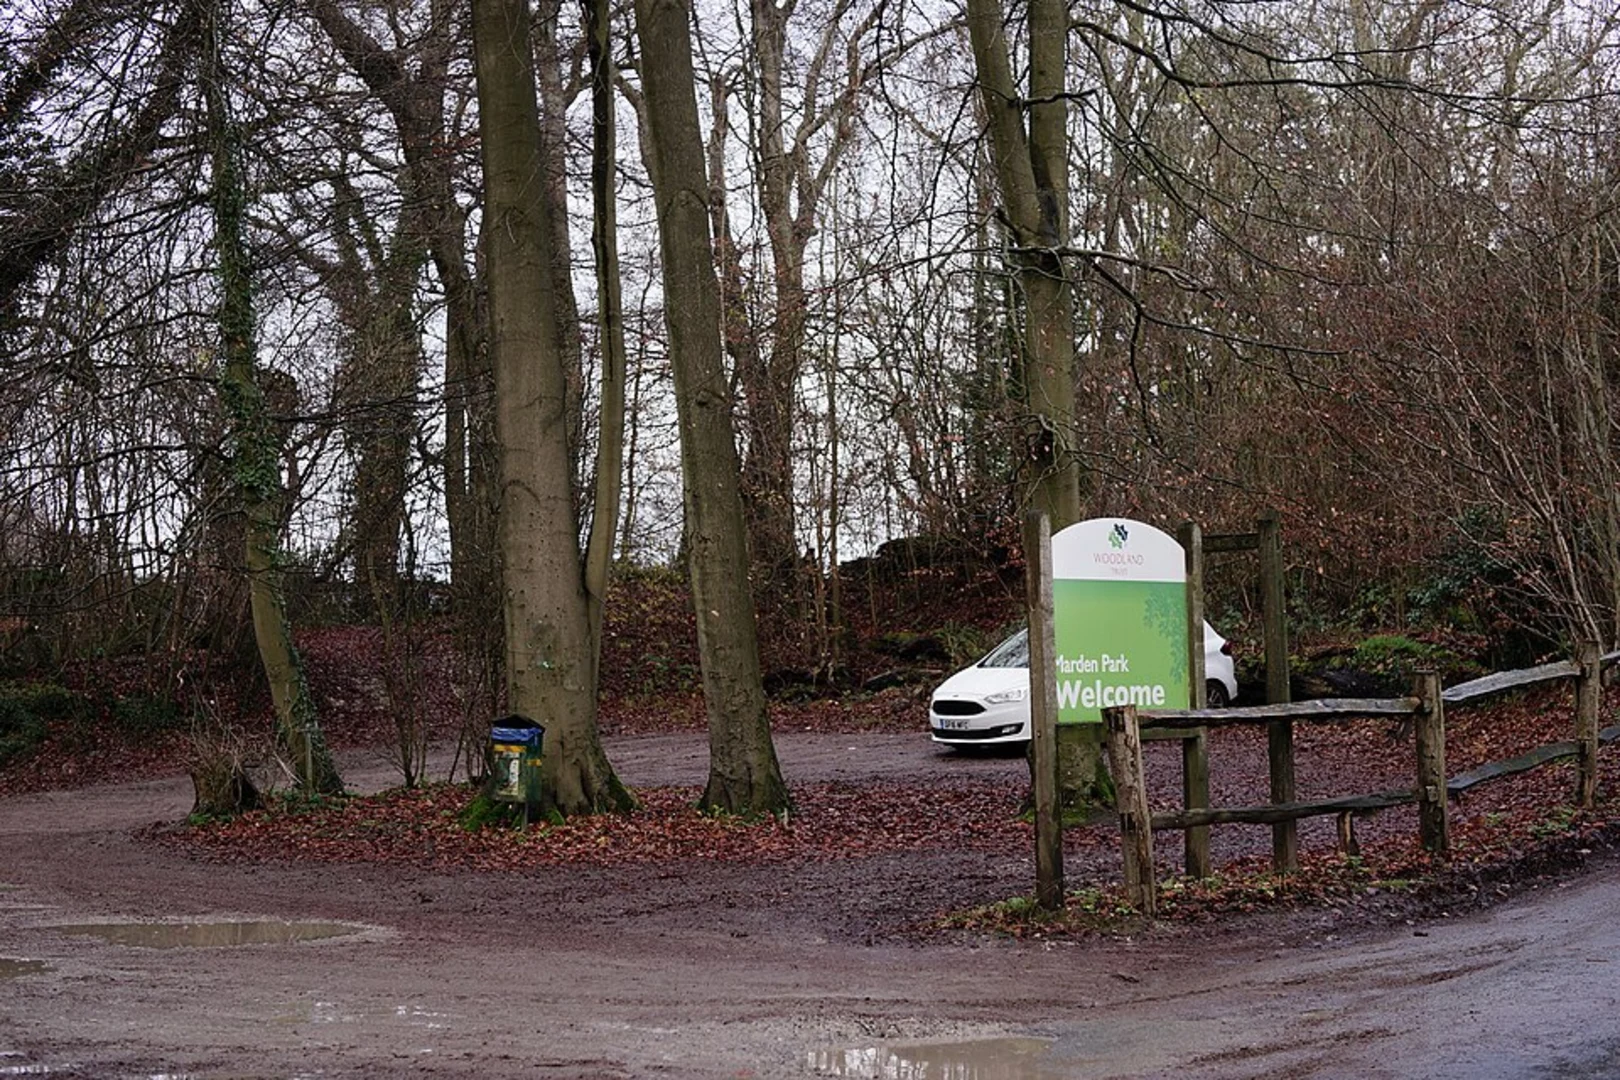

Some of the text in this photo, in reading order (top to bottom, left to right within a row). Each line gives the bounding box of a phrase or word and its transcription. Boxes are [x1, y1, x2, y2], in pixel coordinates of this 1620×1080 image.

[1093, 552, 1145, 566] WOODLAND
[1102, 654, 1129, 673] Park
[1056, 680, 1165, 709] Welcome
